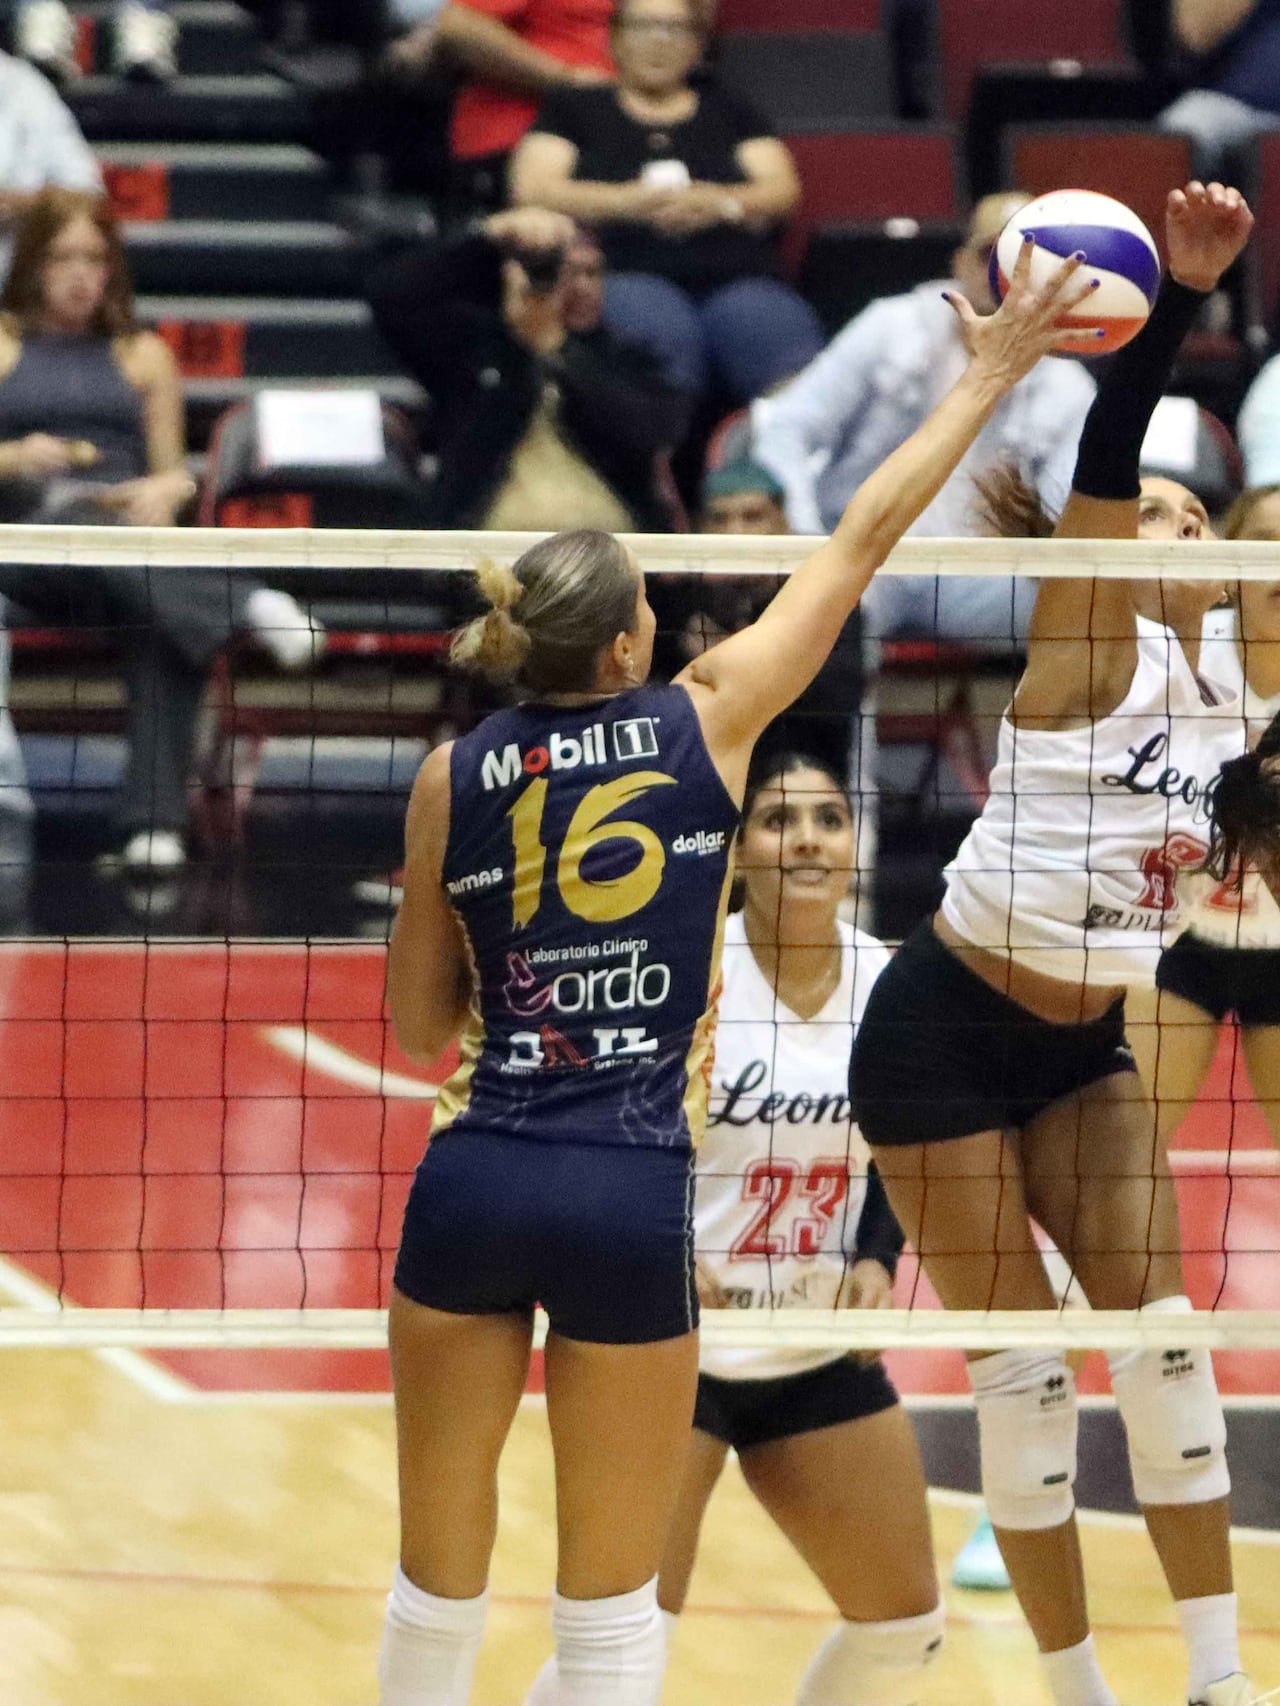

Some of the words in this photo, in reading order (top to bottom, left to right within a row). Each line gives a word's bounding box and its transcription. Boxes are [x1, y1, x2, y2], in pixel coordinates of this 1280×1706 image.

[482, 724, 607, 791] Mobil
[505, 770, 678, 931] 16
[526, 943, 600, 963] Laboratorio
[729, 1157, 857, 1264] 23
